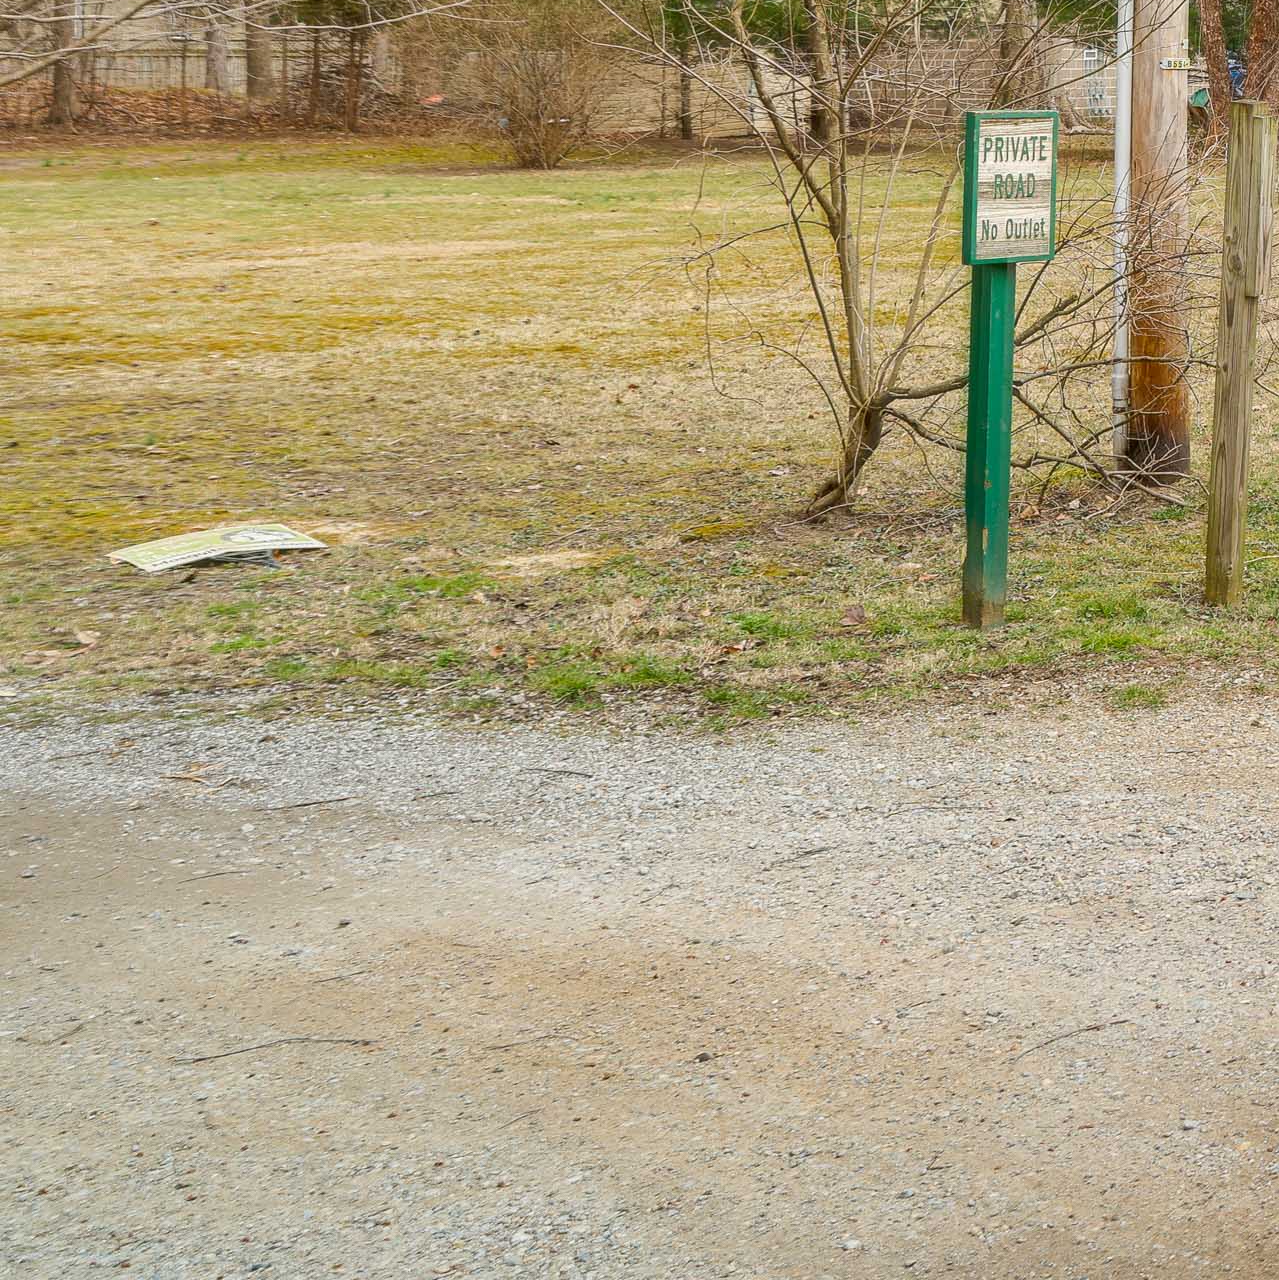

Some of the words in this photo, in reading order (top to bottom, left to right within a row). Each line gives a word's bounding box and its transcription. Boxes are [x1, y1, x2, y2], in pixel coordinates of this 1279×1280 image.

[983, 135, 1048, 163] PRIVATE
[993, 173, 1036, 199] ROAD
[981, 219, 998, 240] No
[1006, 218, 1046, 239] Outlet
